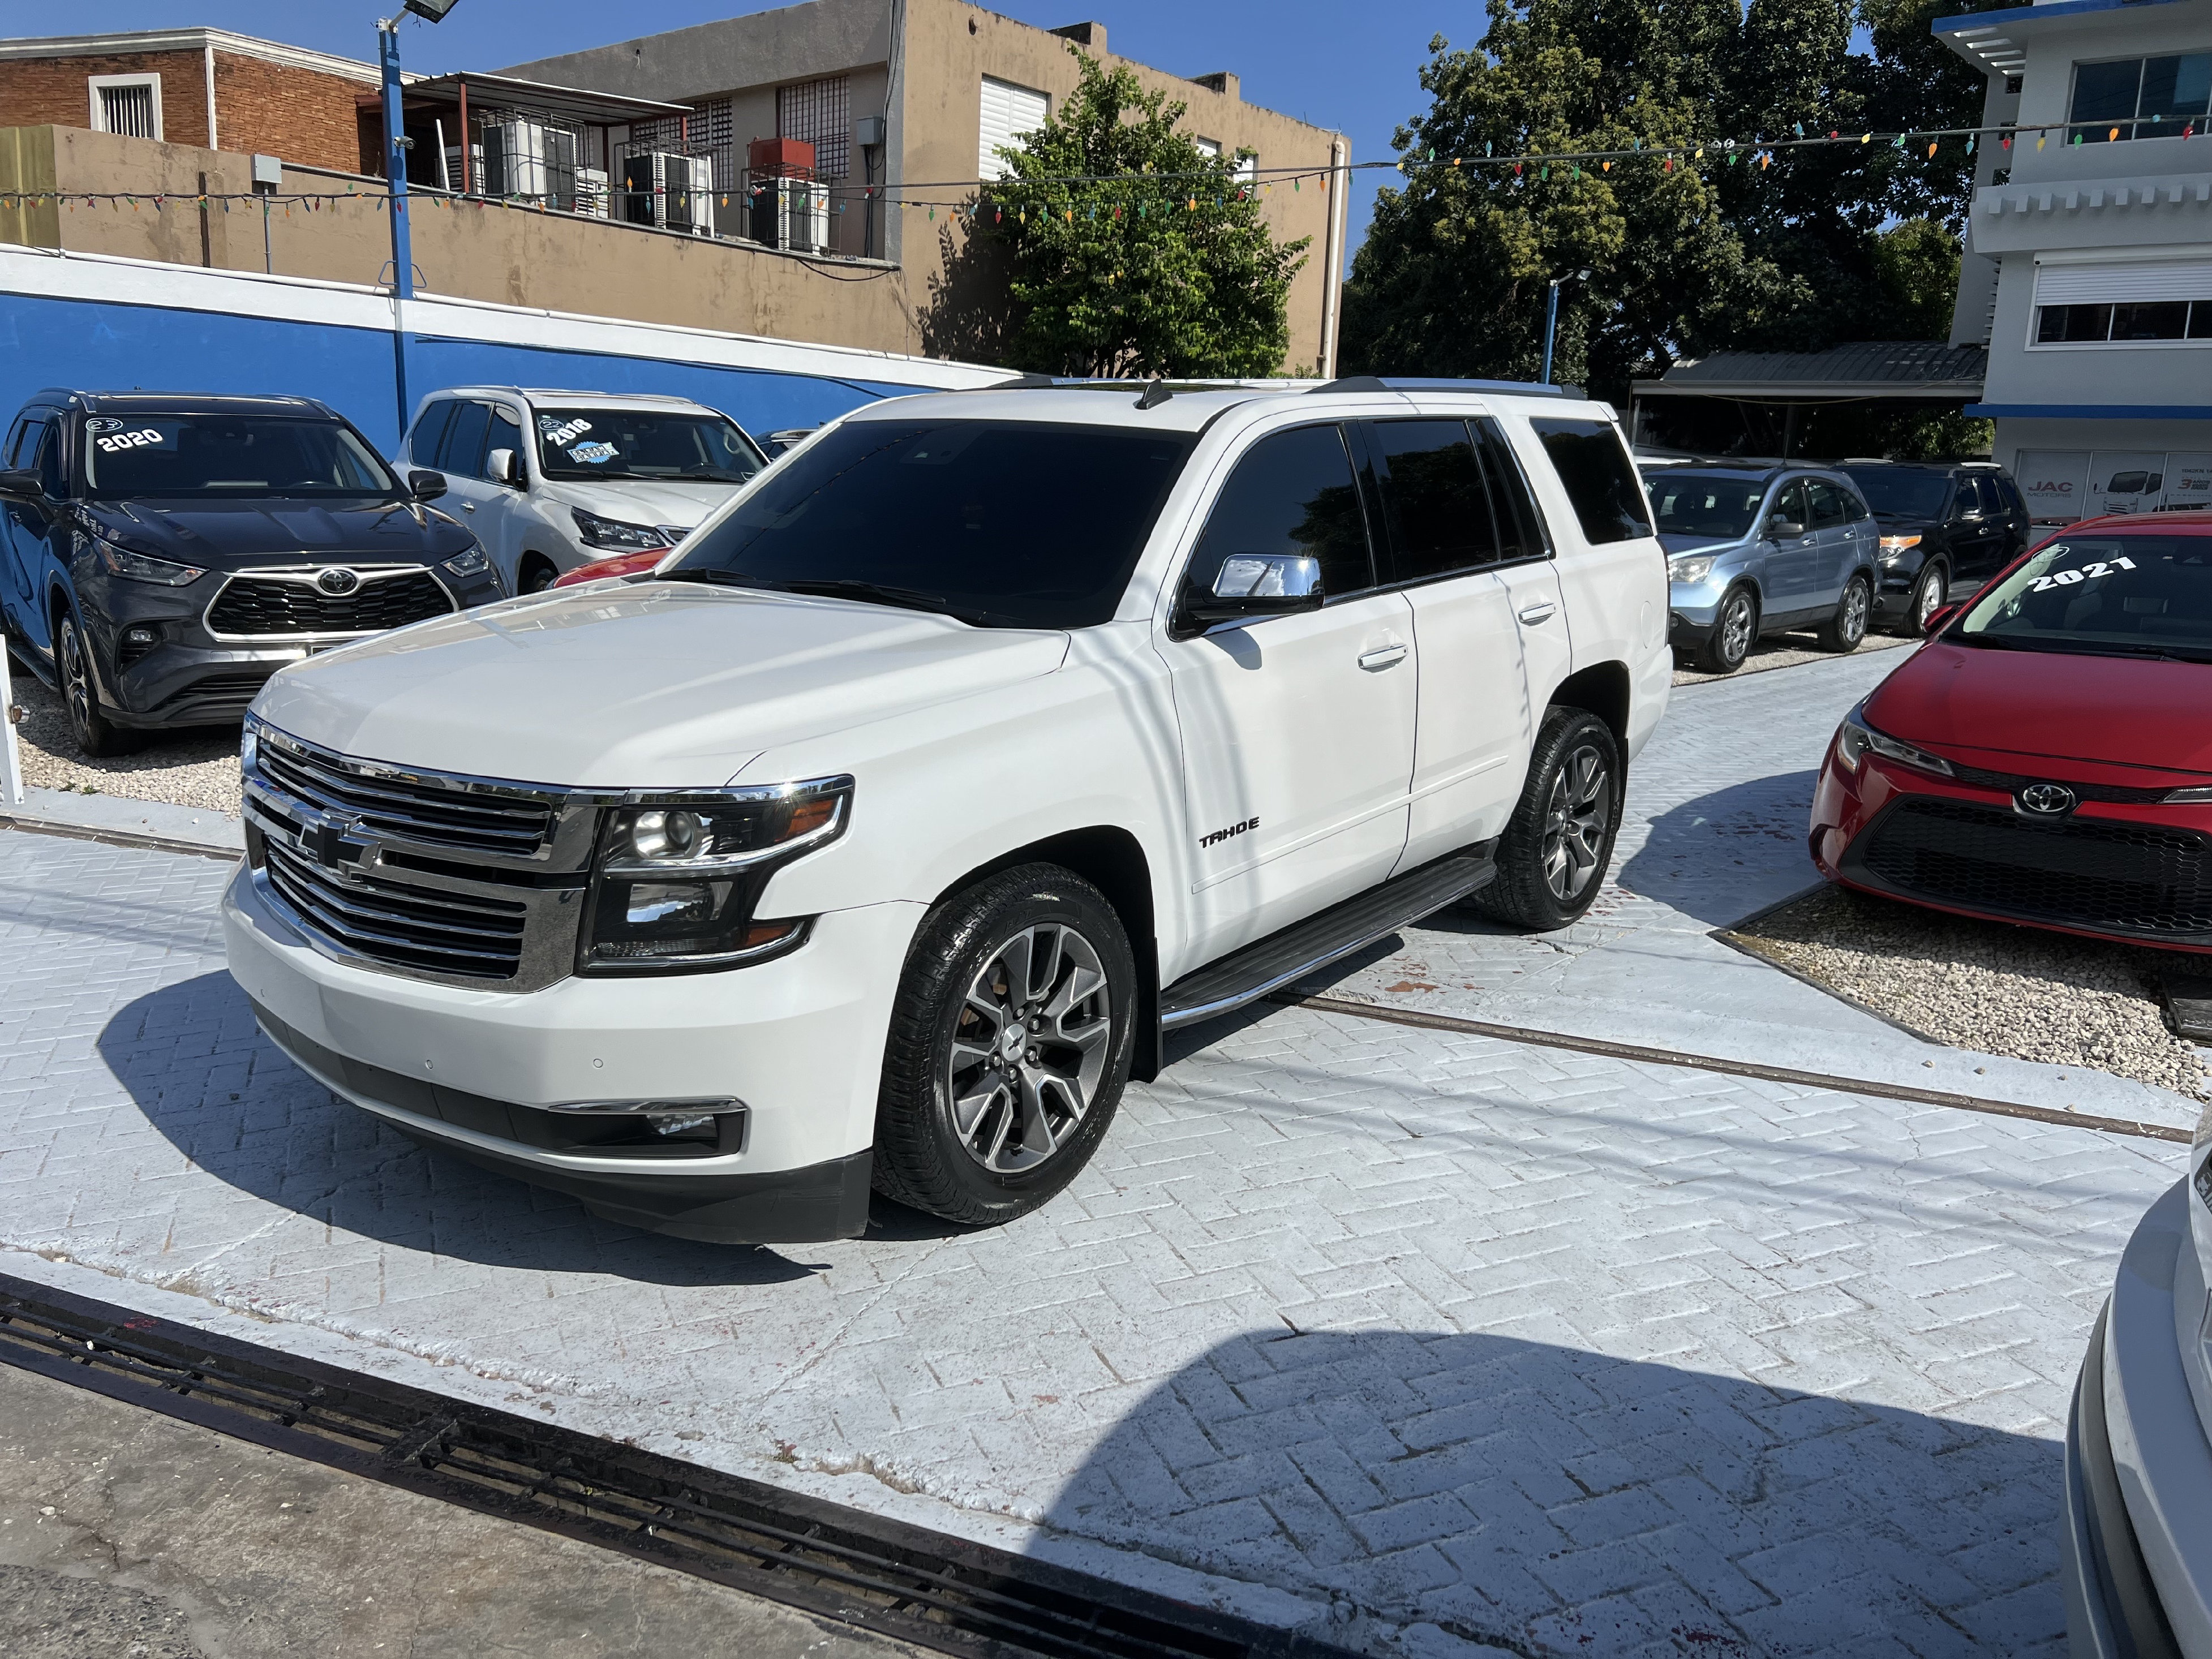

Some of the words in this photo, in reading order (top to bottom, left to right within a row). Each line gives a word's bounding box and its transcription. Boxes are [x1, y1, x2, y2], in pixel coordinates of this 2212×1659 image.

[96, 428, 163, 452] 2020
[546, 418, 592, 446] 2018
[572, 445, 605, 455] CLEAN
[575, 450, 616, 461] CARFAX
[2028, 480, 2073, 492] JAC
[2027, 556, 2137, 592] 2021
[1199, 816, 1260, 849] TAHOE
